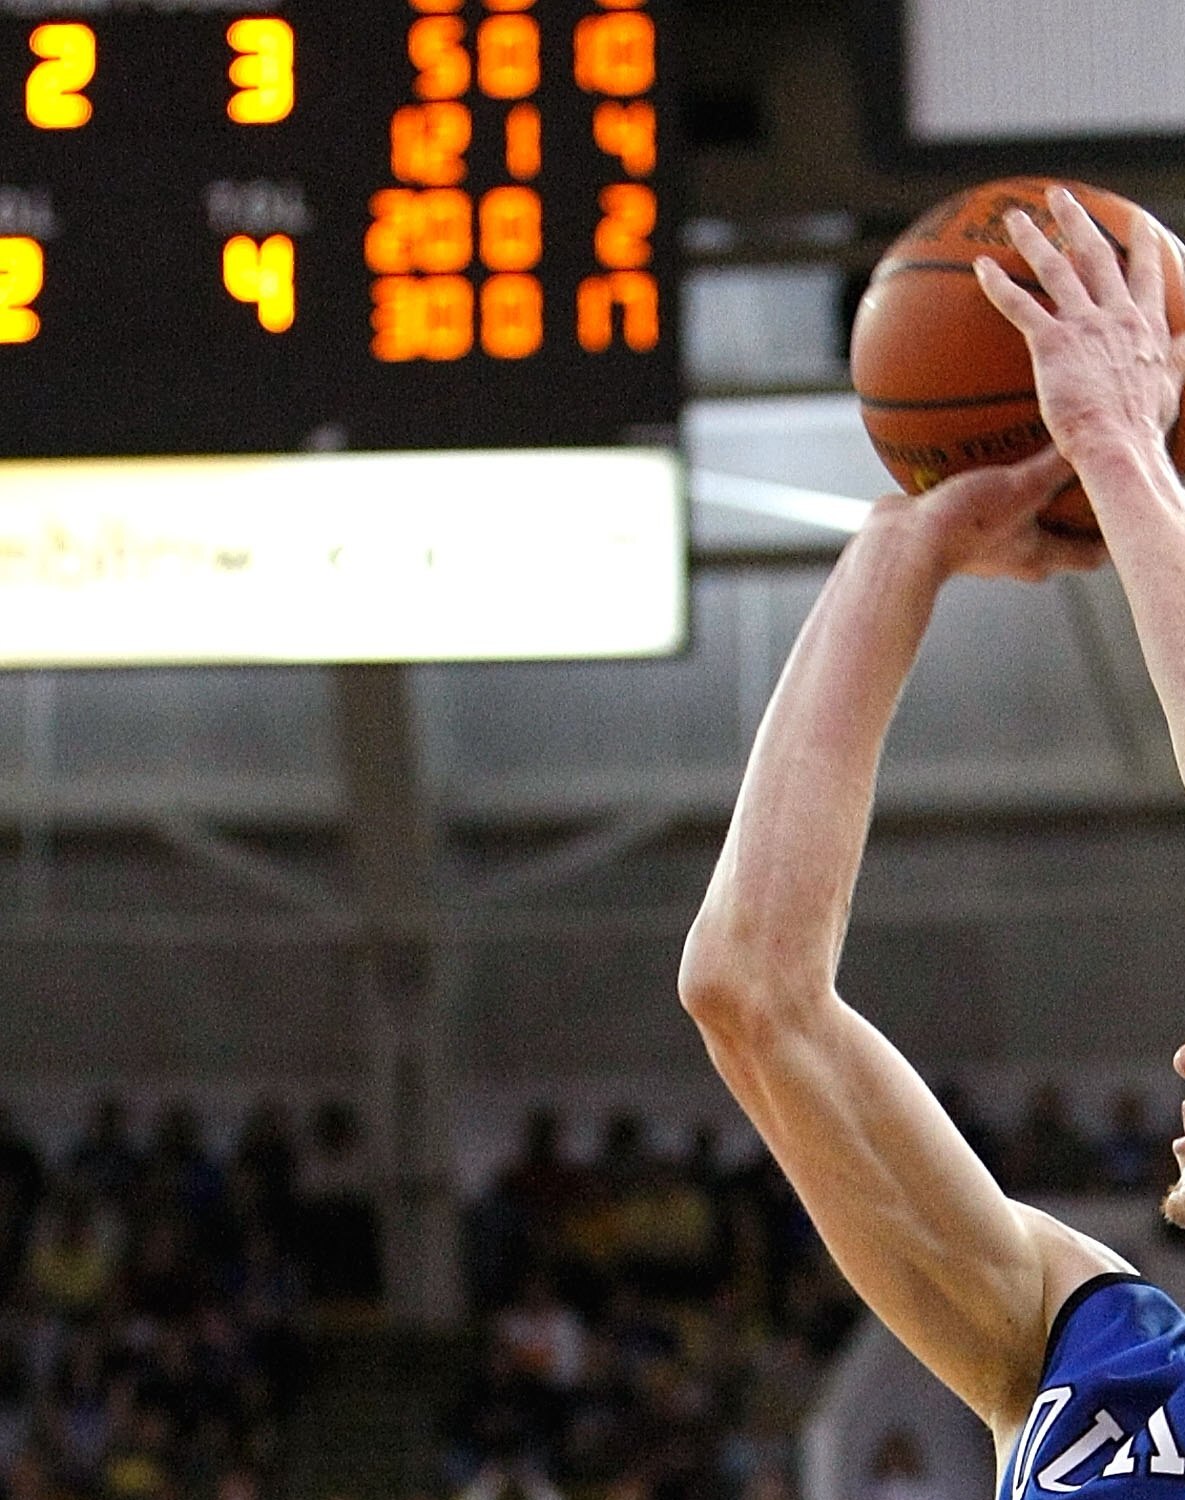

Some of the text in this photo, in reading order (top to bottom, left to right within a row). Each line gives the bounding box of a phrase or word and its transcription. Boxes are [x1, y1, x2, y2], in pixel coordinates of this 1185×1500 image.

[25, 22, 97, 130] 2
[226, 16, 296, 125] 3
[594, 183, 658, 270] 2
[222, 233, 296, 334] 4
